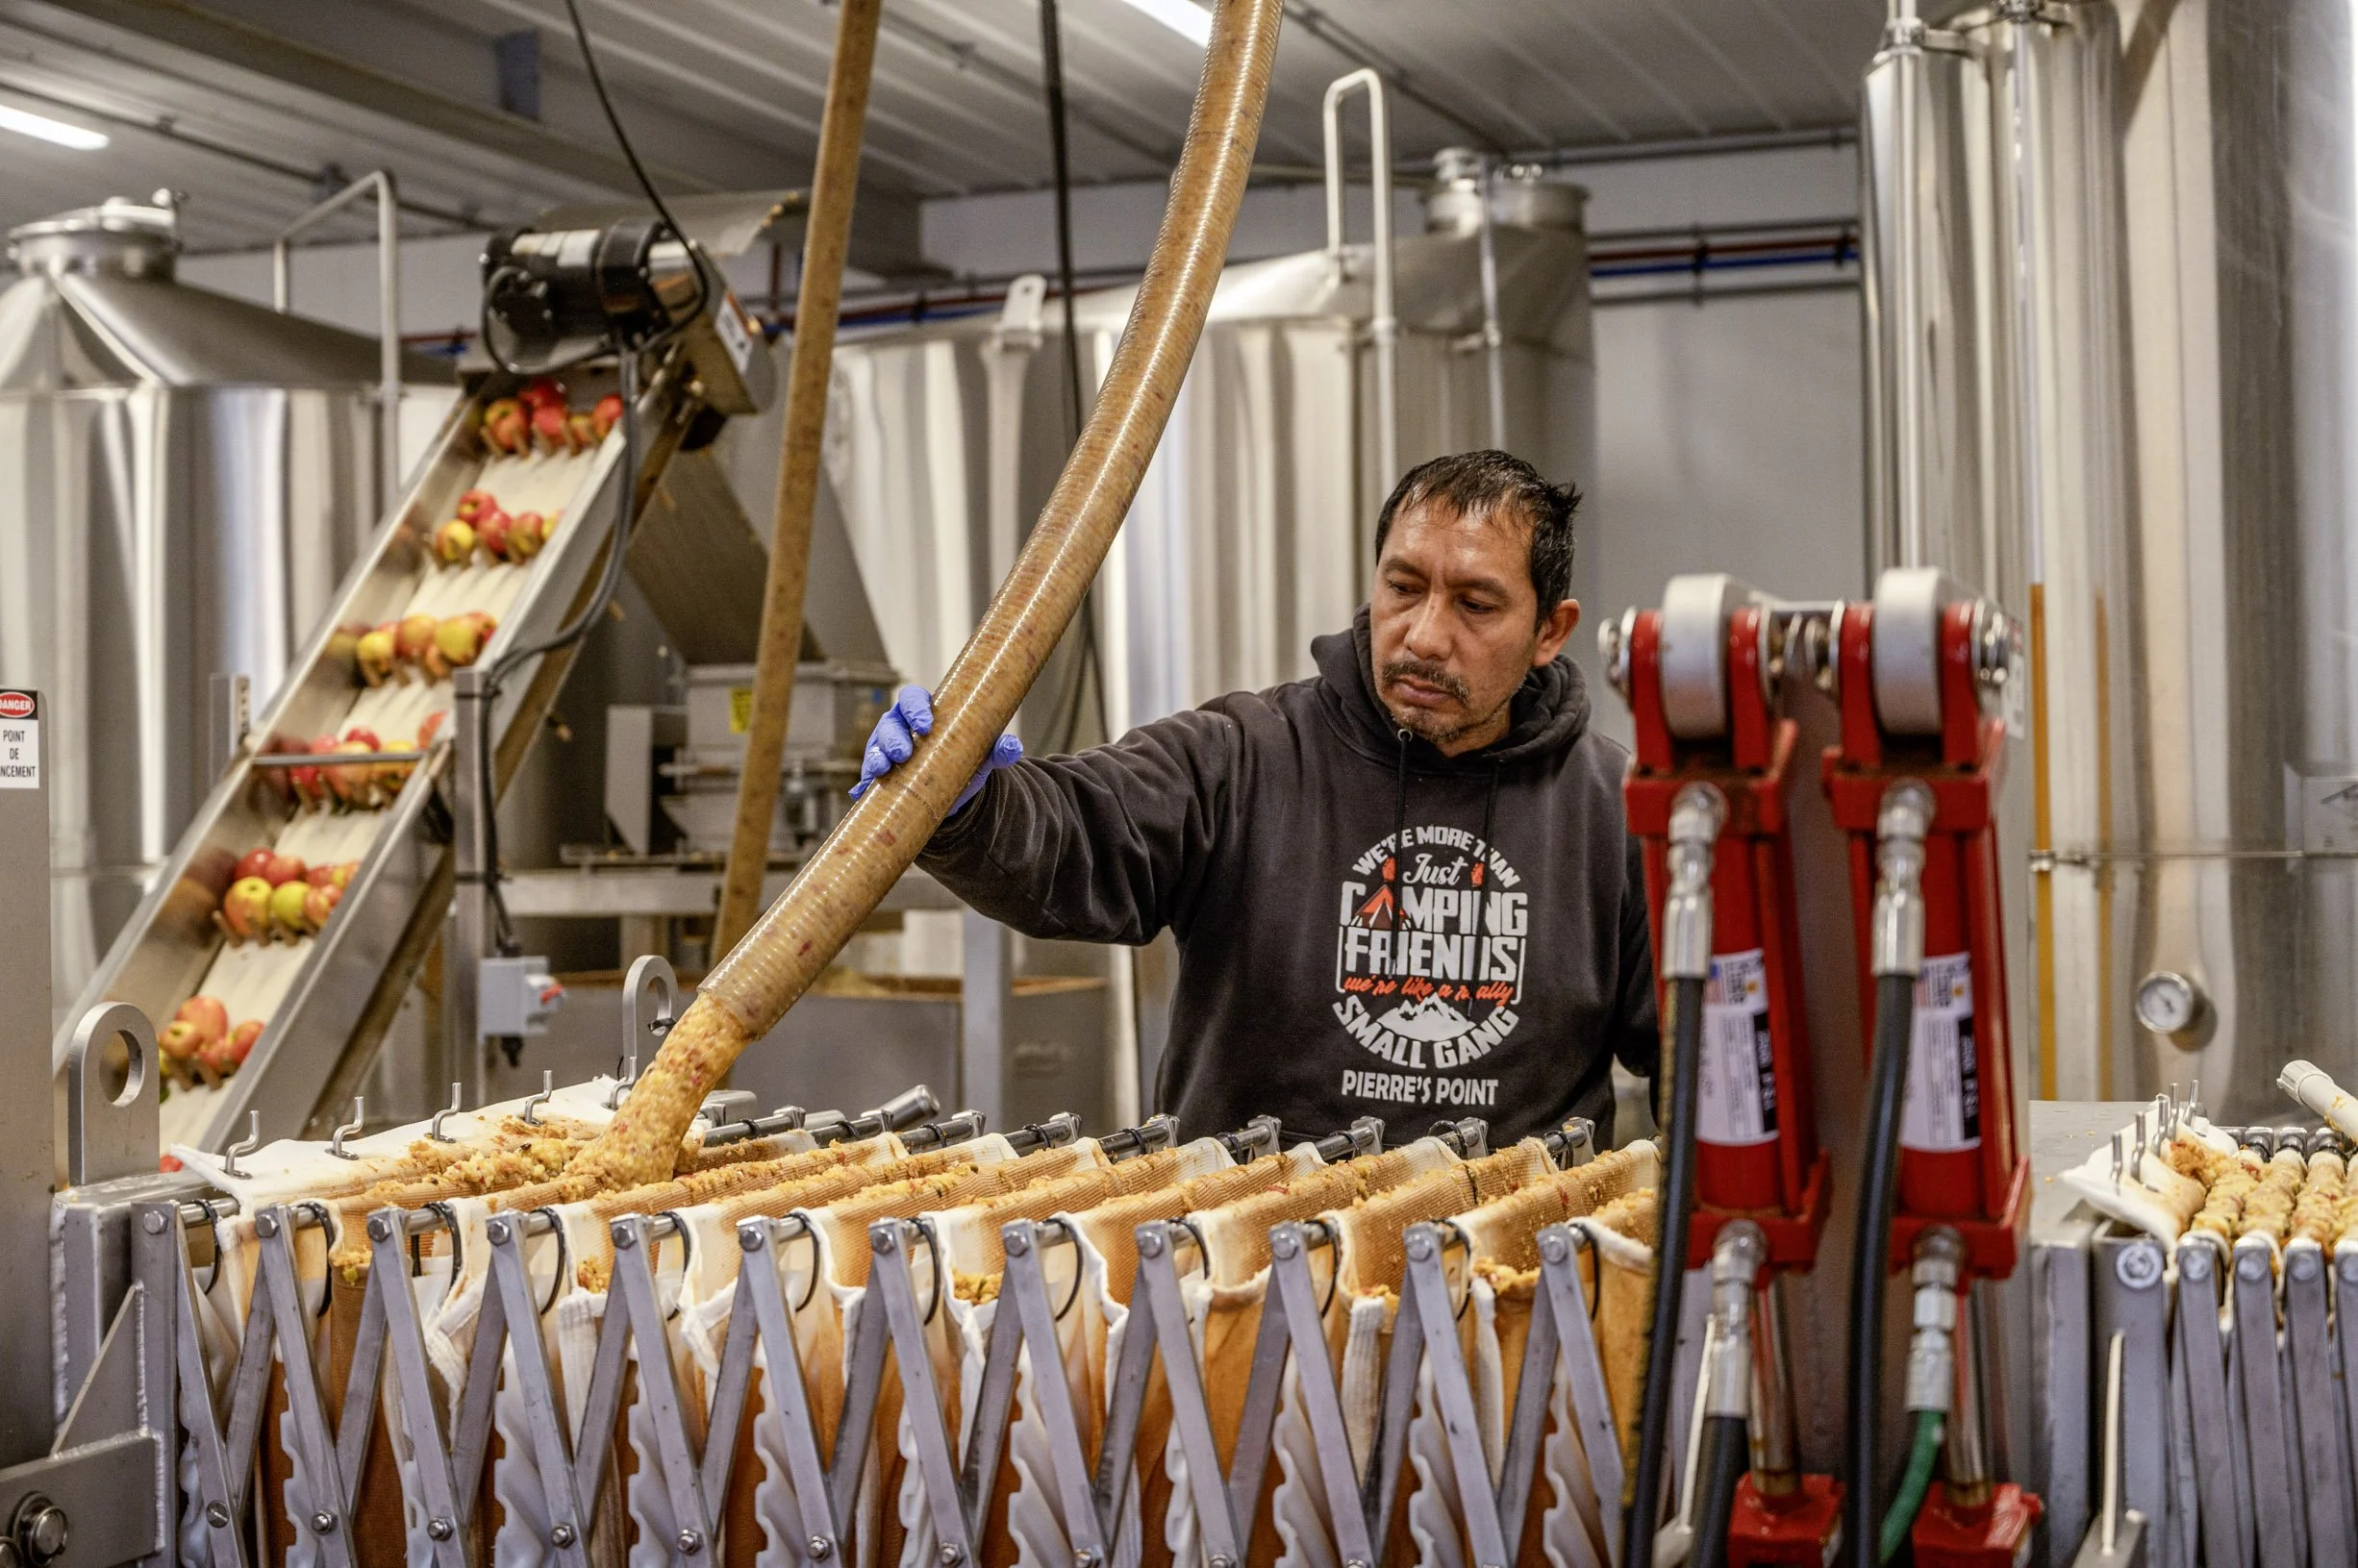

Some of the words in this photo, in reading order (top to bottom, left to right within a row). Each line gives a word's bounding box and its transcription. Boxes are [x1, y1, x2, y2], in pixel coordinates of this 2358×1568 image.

[3, 730, 25, 743] POINT
[10, 748, 19, 760] DE
[1416, 826, 1474, 852] MORE
[1402, 853, 1468, 885] Just
[1343, 974, 1398, 996] we're
[1400, 976, 1435, 1003] like
[1437, 983, 1454, 999] a
[1454, 981, 1515, 1008] rally
[1332, 994, 1427, 1069] SMALL
[1433, 1005, 1520, 1069] GANG
[1341, 1069, 1433, 1105] PIERRE'S
[1435, 1078, 1499, 1106] POINT
